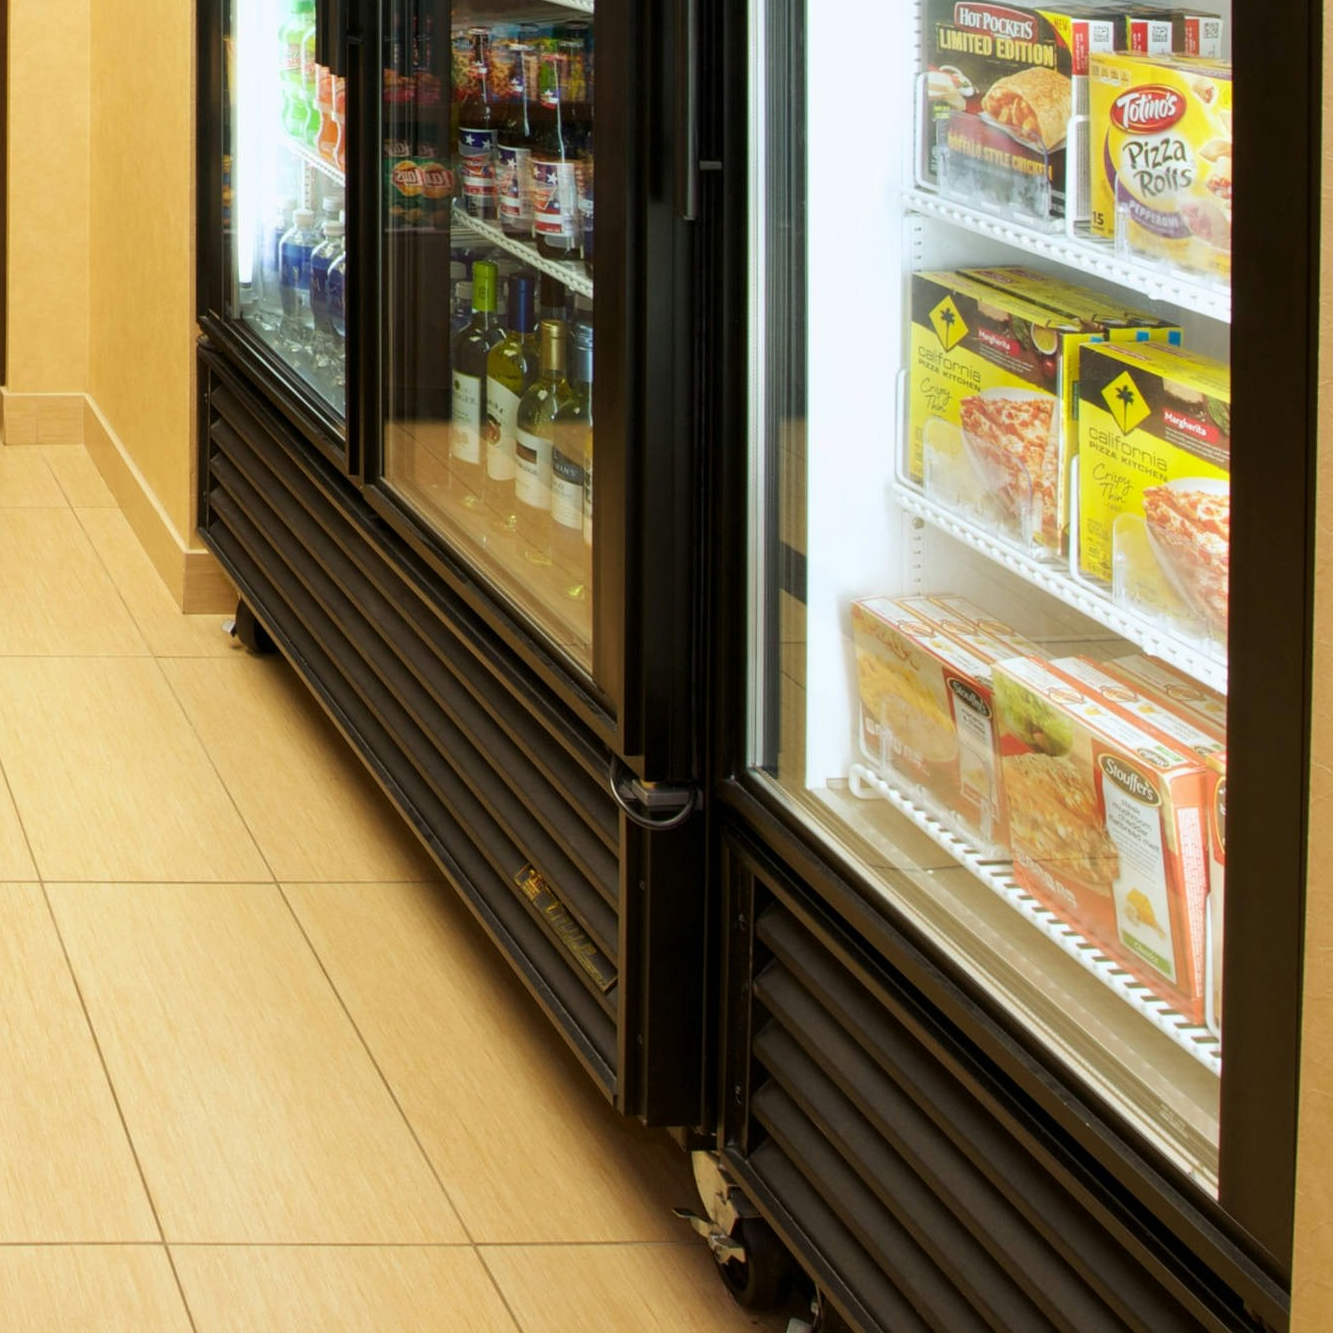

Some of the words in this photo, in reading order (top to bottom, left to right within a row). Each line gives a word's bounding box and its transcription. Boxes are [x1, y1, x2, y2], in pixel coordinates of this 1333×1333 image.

[959, 7, 982, 28] HOT
[983, 13, 1033, 39] POCKETS
[939, 28, 992, 57] LIMITED
[996, 37, 1054, 66] EDITION
[1117, 91, 1178, 128] Totino's
[1122, 138, 1187, 169] Pizza
[1134, 166, 1193, 198] Rolls
[1092, 211, 1104, 226] 15
[979, 329, 1011, 351] Margherita
[918, 346, 981, 383] california
[920, 378, 953, 404] Crispy
[942, 370, 981, 392] KITCHEN
[1164, 412, 1207, 437] Margherita
[1088, 426, 1168, 471] california
[1088, 441, 1118, 461] PIZZA
[1121, 456, 1168, 482] KITCHEN
[1092, 462, 1134, 491] Crispy
[1099, 483, 1126, 504] Thin
